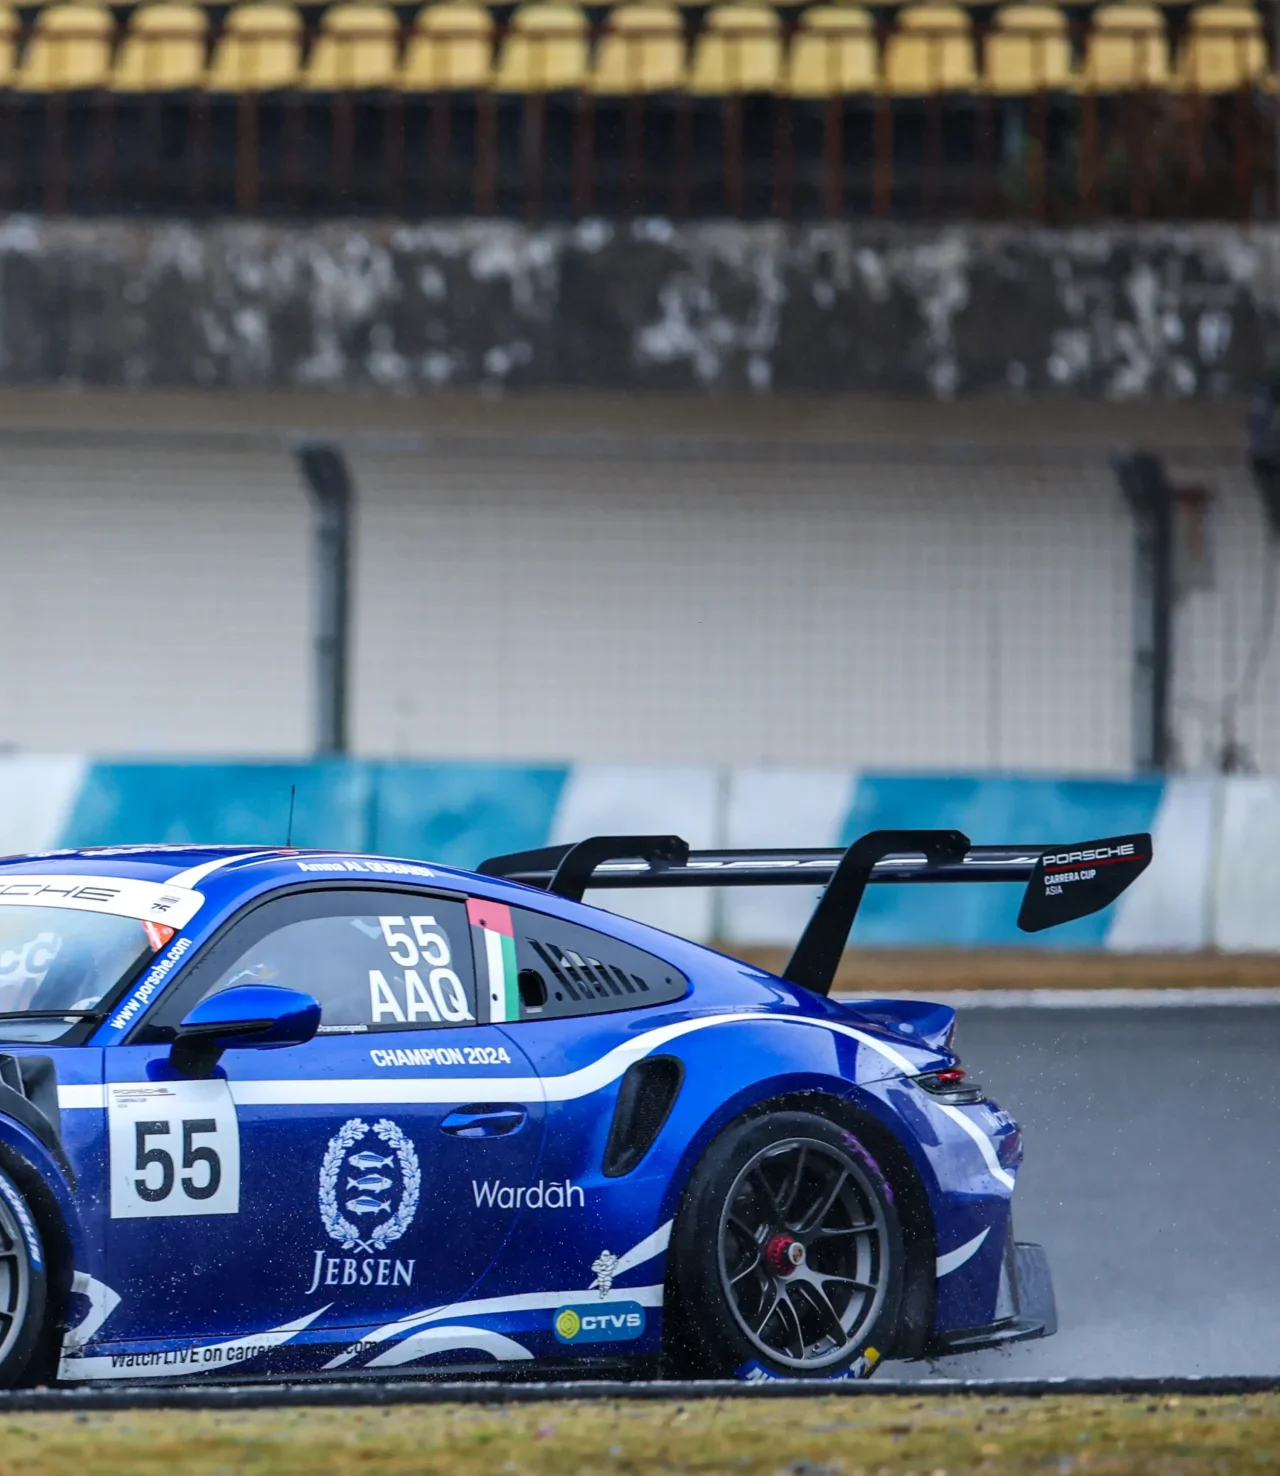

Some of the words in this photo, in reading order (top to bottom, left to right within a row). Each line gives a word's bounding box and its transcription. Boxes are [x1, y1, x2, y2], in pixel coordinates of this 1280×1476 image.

[1042, 843, 1135, 866] PORSCHE
[344, 860, 370, 873] AL
[1044, 872, 1080, 885] CARRERA
[1080, 869, 1097, 880] CUP
[1045, 885, 1064, 896] ASIA
[377, 915, 451, 967] 55
[109, 936, 193, 1030] wwwporsche.com
[368, 967, 476, 1022] AAQ
[370, 1048, 465, 1067] CHAMPION
[464, 1047, 511, 1065] 2024
[134, 1118, 222, 1202] 55
[581, 1312, 641, 1331] CTVS
[204, 1349, 222, 1362] on
